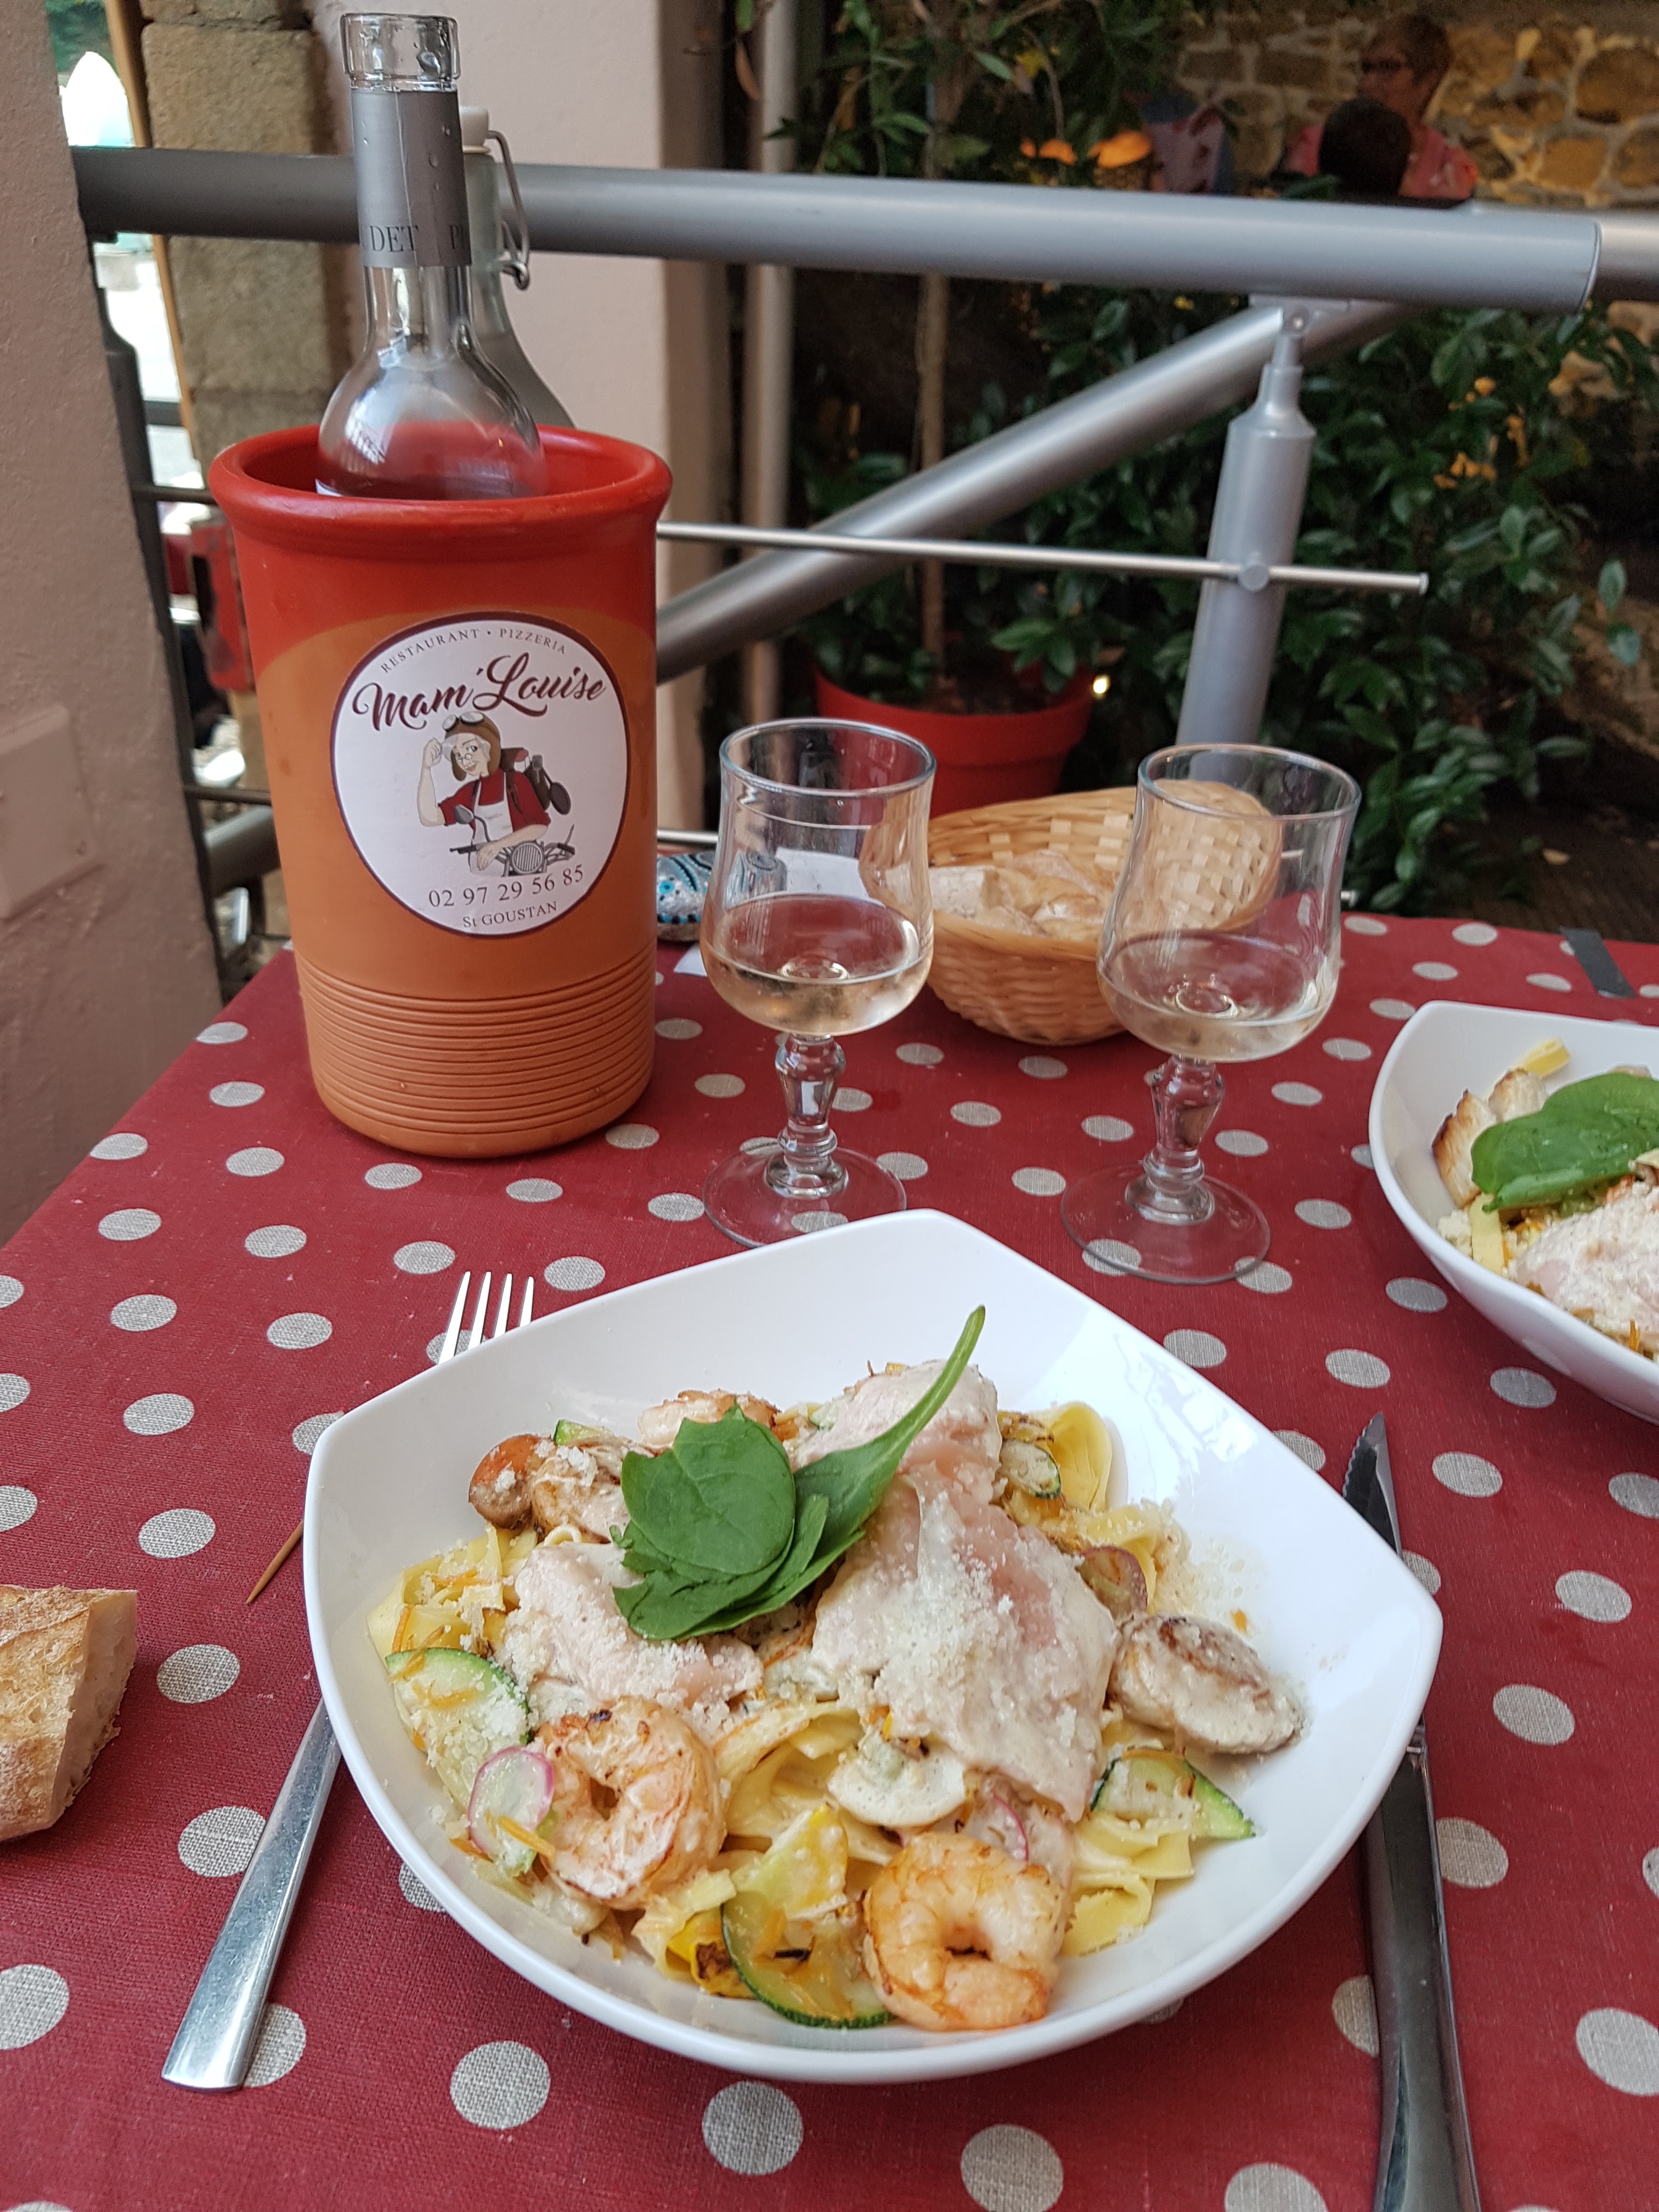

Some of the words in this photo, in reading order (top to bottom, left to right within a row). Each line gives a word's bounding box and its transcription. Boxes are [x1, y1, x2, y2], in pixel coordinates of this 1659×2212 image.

[360, 225, 419, 252] DET
[381, 629, 479, 673] RESTAURANT
[500, 628, 567, 654] PIZZERIA
[428, 889, 455, 907] 02
[462, 887, 488, 905] 97
[498, 881, 523, 901] 29
[532, 873, 555, 894] 56
[563, 864, 584, 886] 85
[462, 916, 477, 928] St
[482, 901, 557, 926] GOUSTAN
